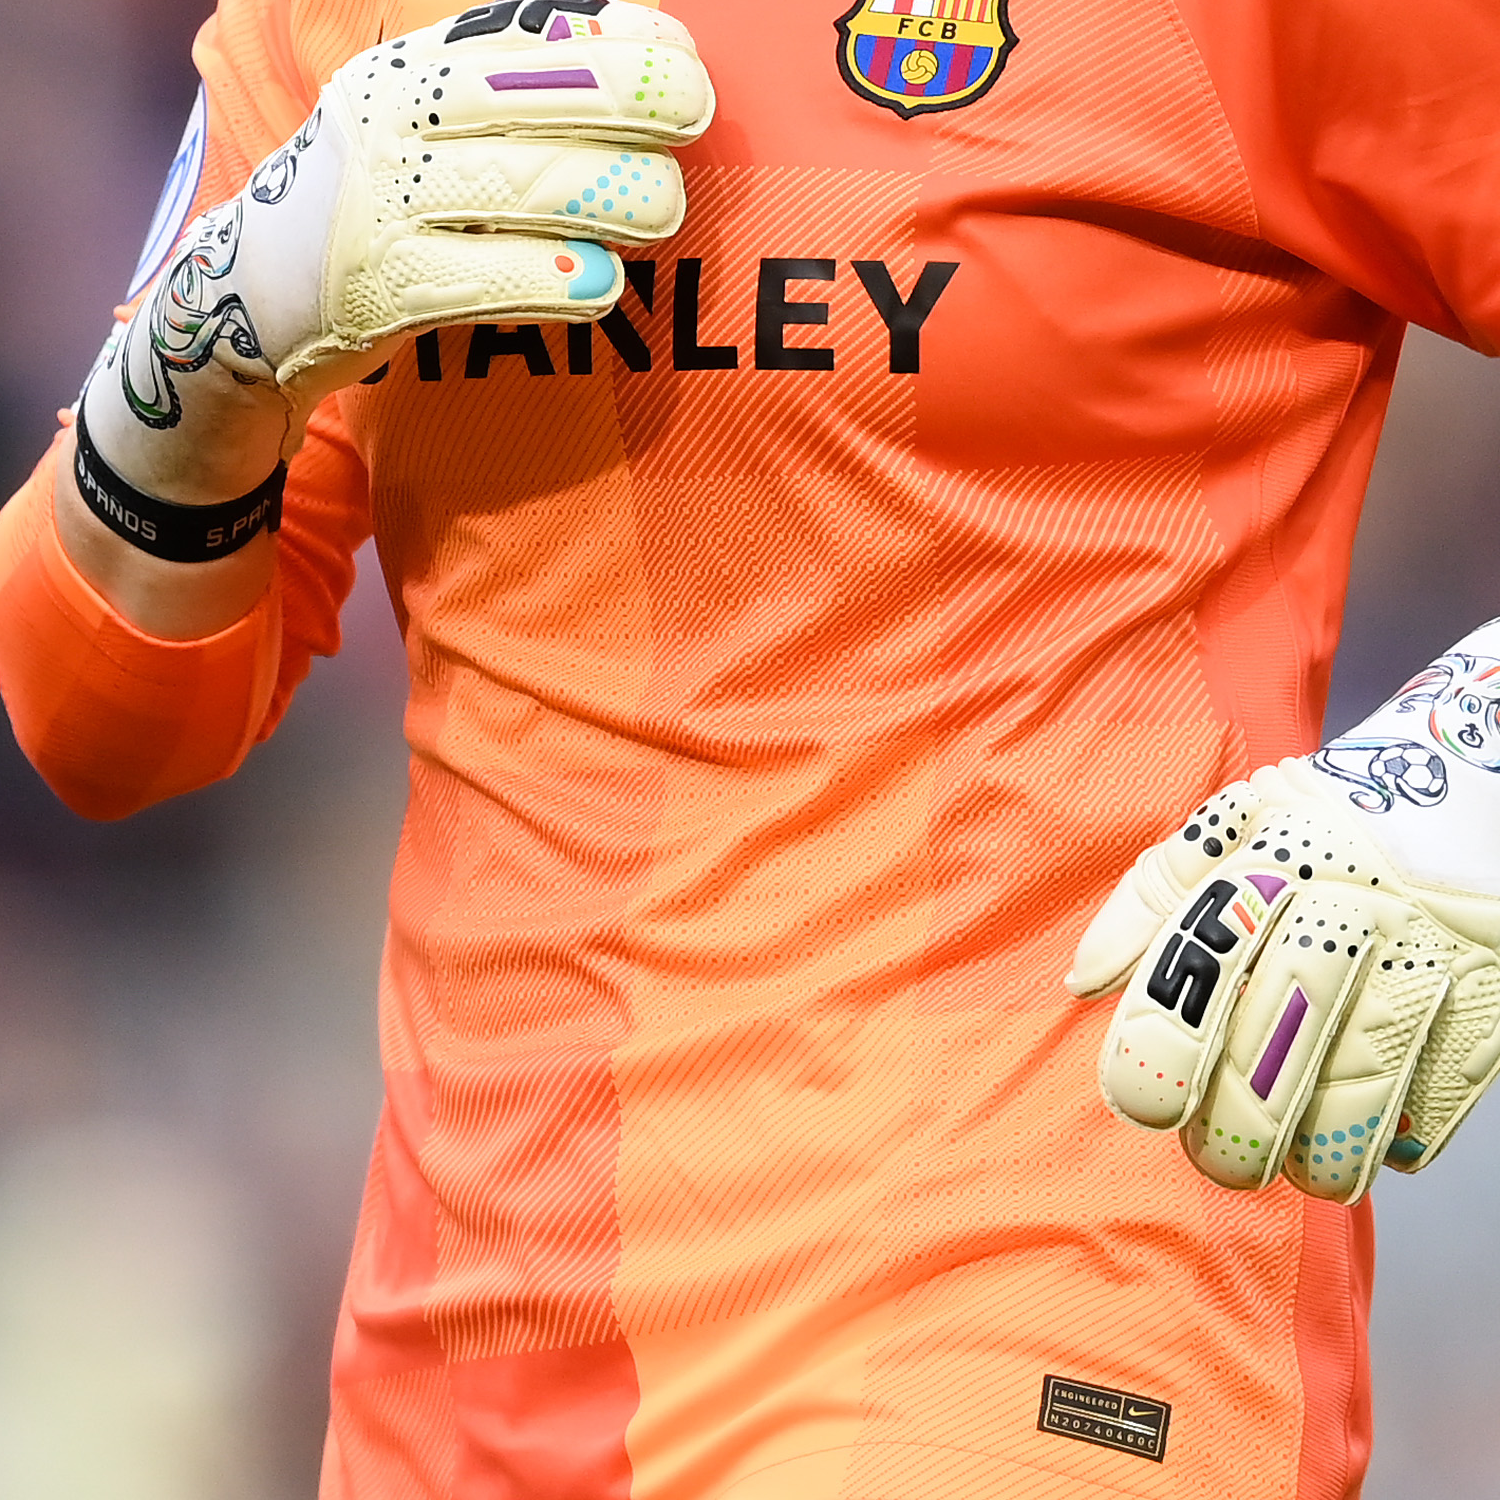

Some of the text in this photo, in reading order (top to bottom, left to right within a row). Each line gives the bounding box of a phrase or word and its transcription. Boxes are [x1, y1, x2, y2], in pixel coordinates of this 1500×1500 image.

[897, 17, 957, 40] FCB
[359, 257, 960, 385] ANLEY
[1054, 1388, 1118, 1410] ENGINEERED
